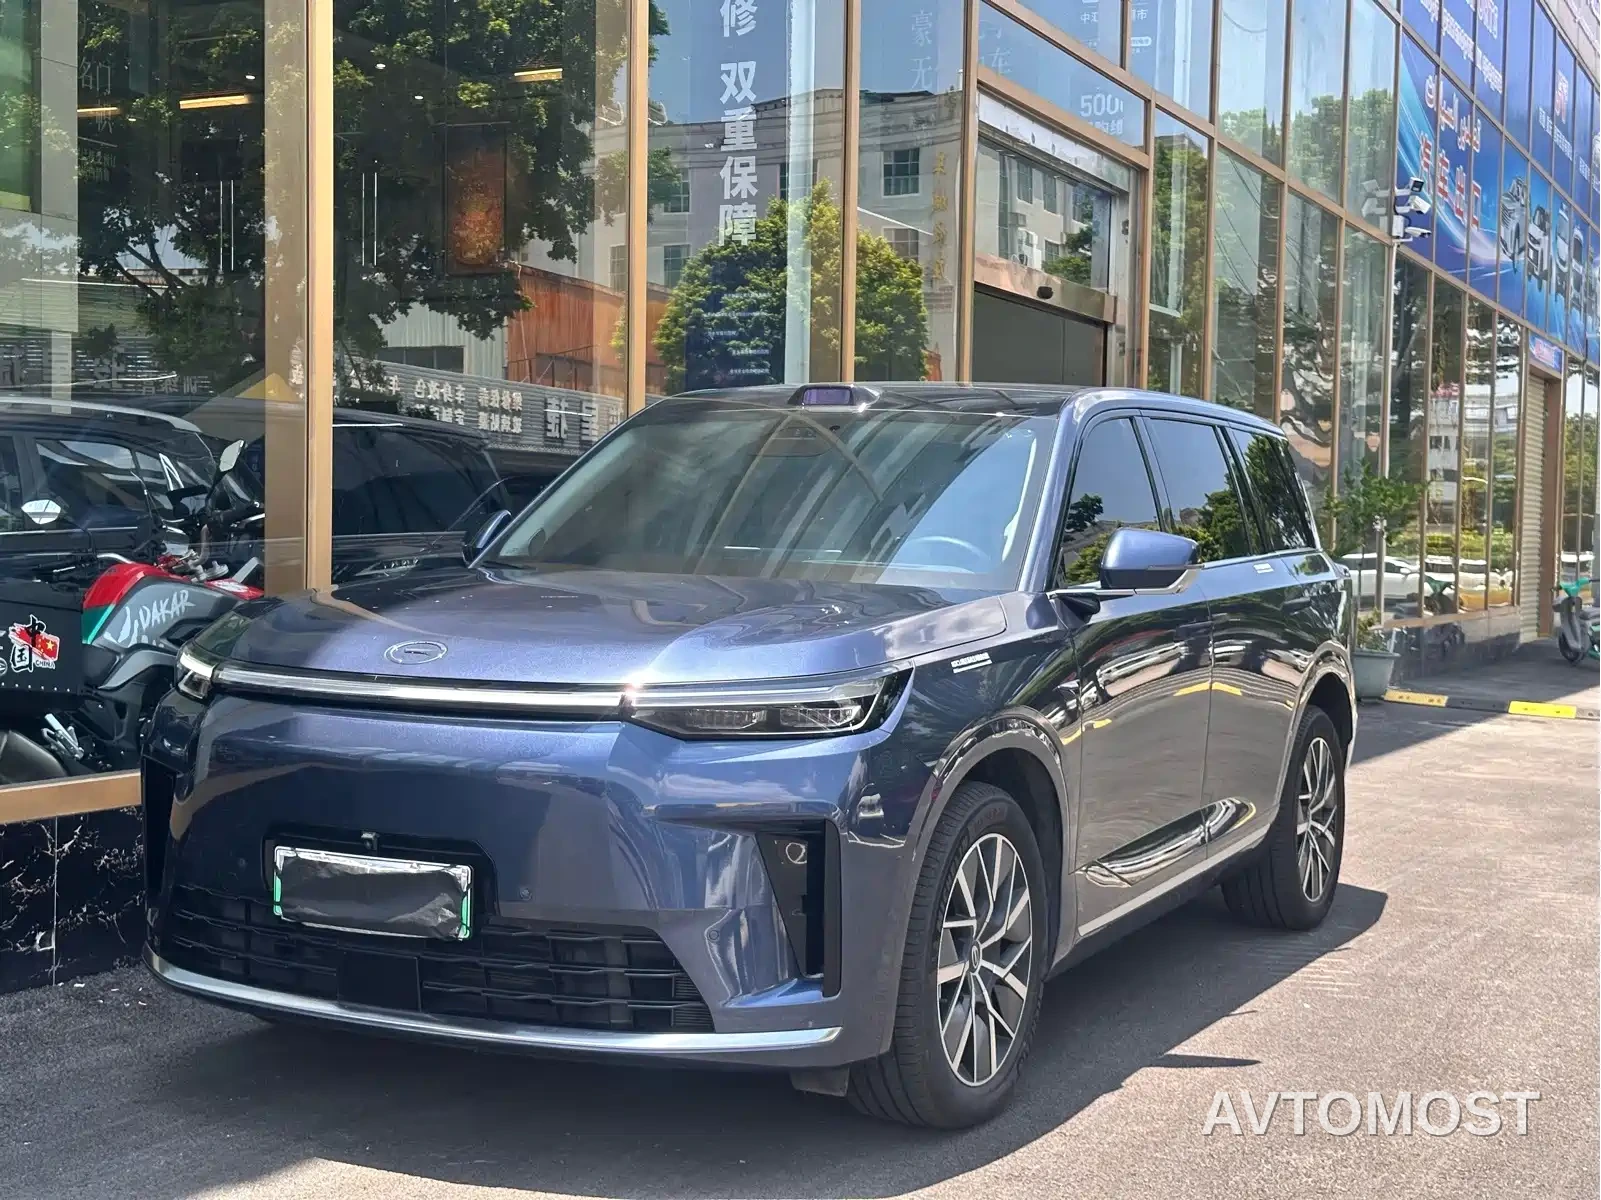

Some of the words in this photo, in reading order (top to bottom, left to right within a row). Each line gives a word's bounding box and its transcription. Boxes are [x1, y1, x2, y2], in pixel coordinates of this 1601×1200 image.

[1079, 93, 1125, 117] 500
[718, 60, 759, 247] 双重保障
[138, 589, 196, 630] DAKAR
